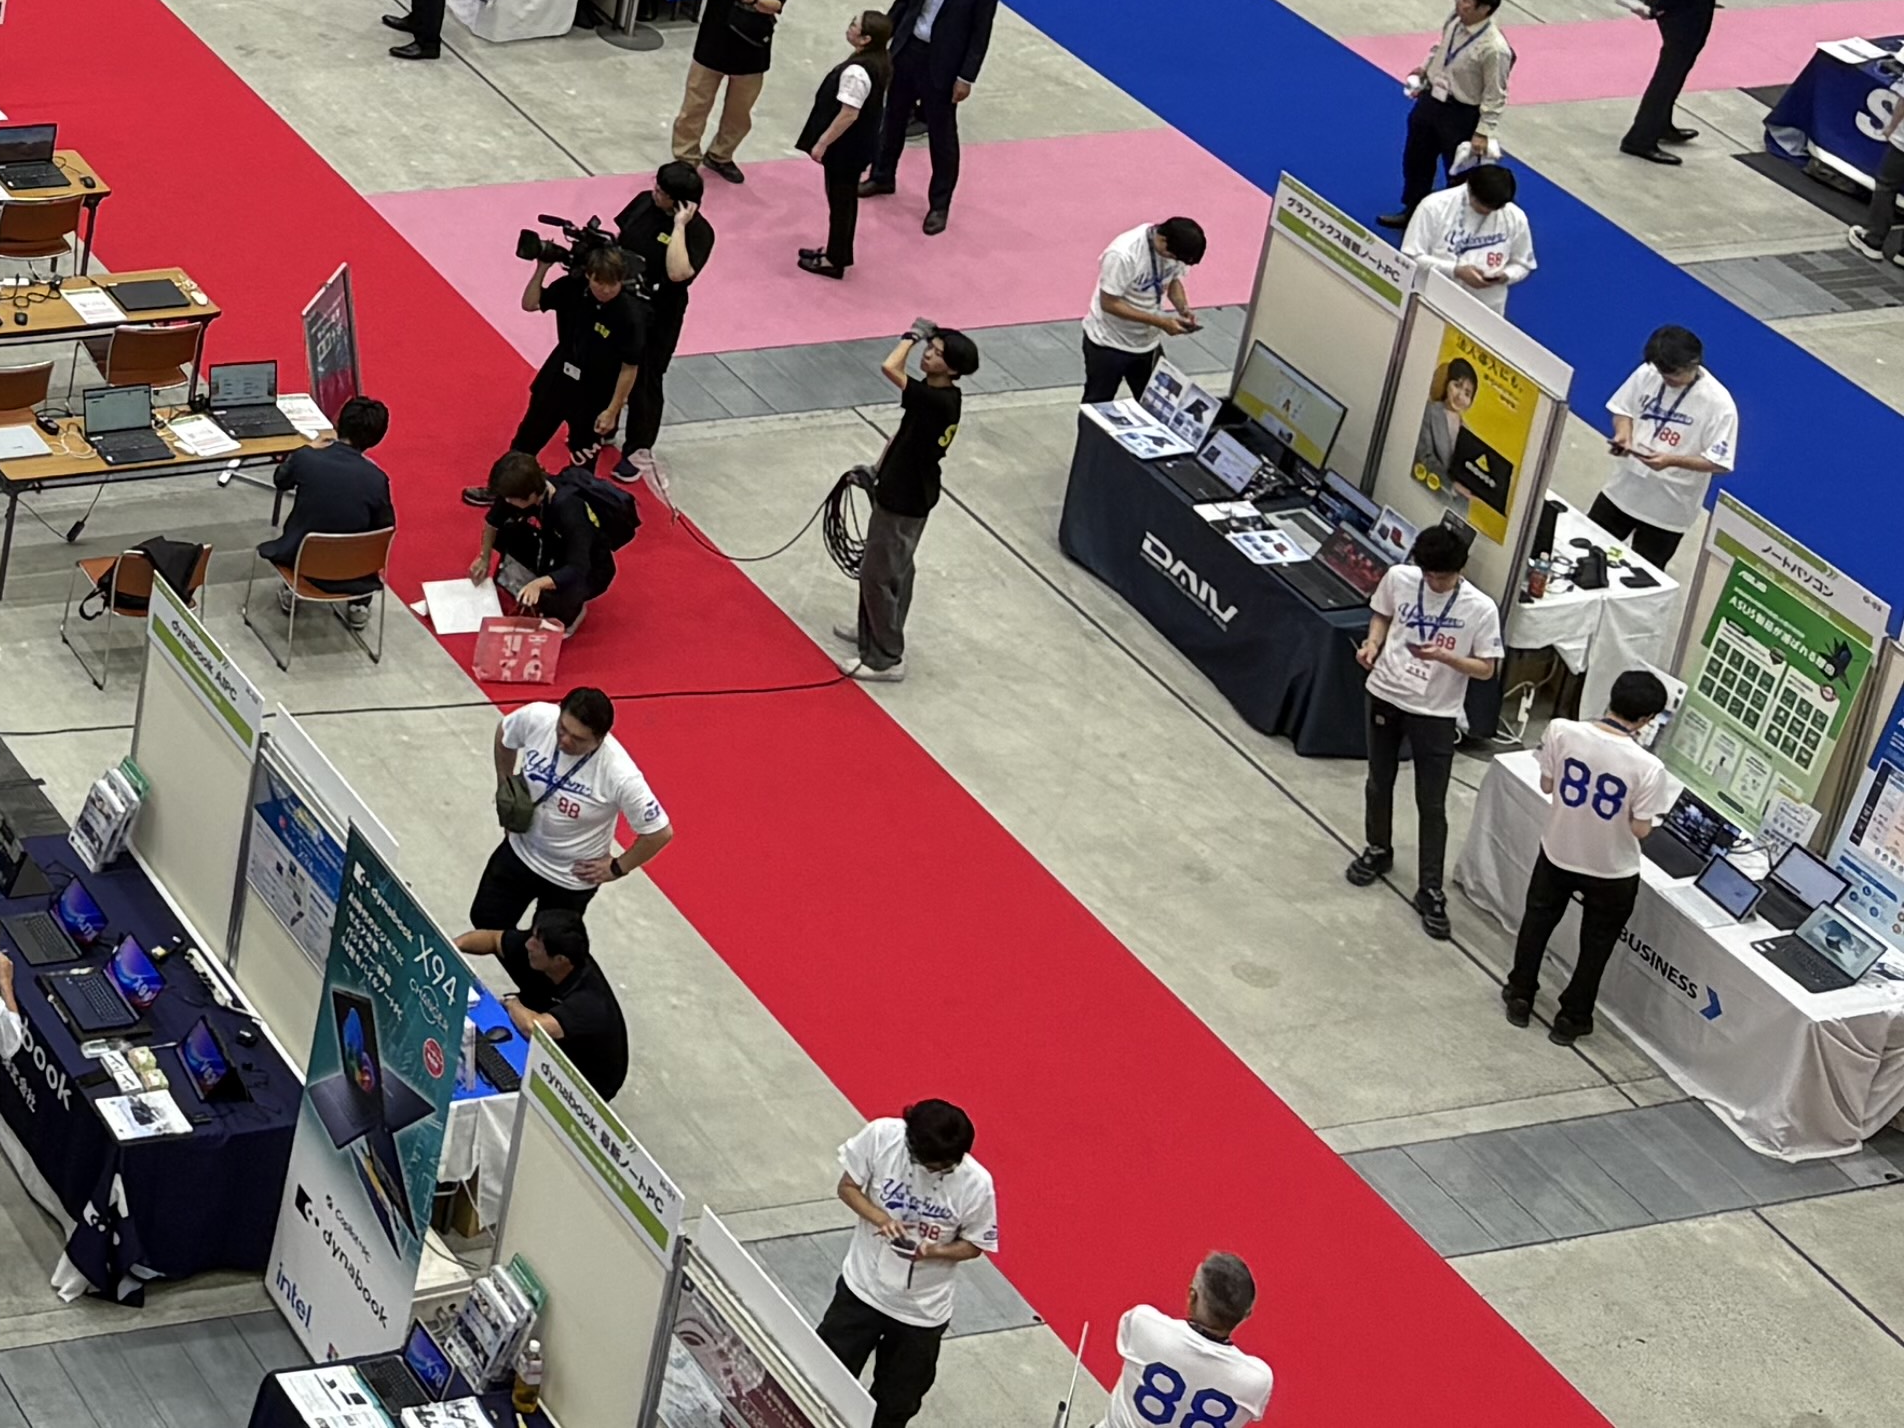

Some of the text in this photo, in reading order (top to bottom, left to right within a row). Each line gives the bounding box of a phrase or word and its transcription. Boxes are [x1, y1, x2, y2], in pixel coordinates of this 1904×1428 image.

[1659, 427, 1680, 446] 88
[1761, 545, 1834, 597] ノートパソコン
[1435, 633, 1456, 650] 88
[557, 796, 581, 820] 88
[1559, 756, 1629, 821] 88
[414, 934, 457, 1007] X94
[1616, 928, 1698, 1001] BUSINESS
[539, 1060, 598, 1129] dynabook
[275, 1261, 313, 1329] intel
[322, 1229, 389, 1330] dynabook
